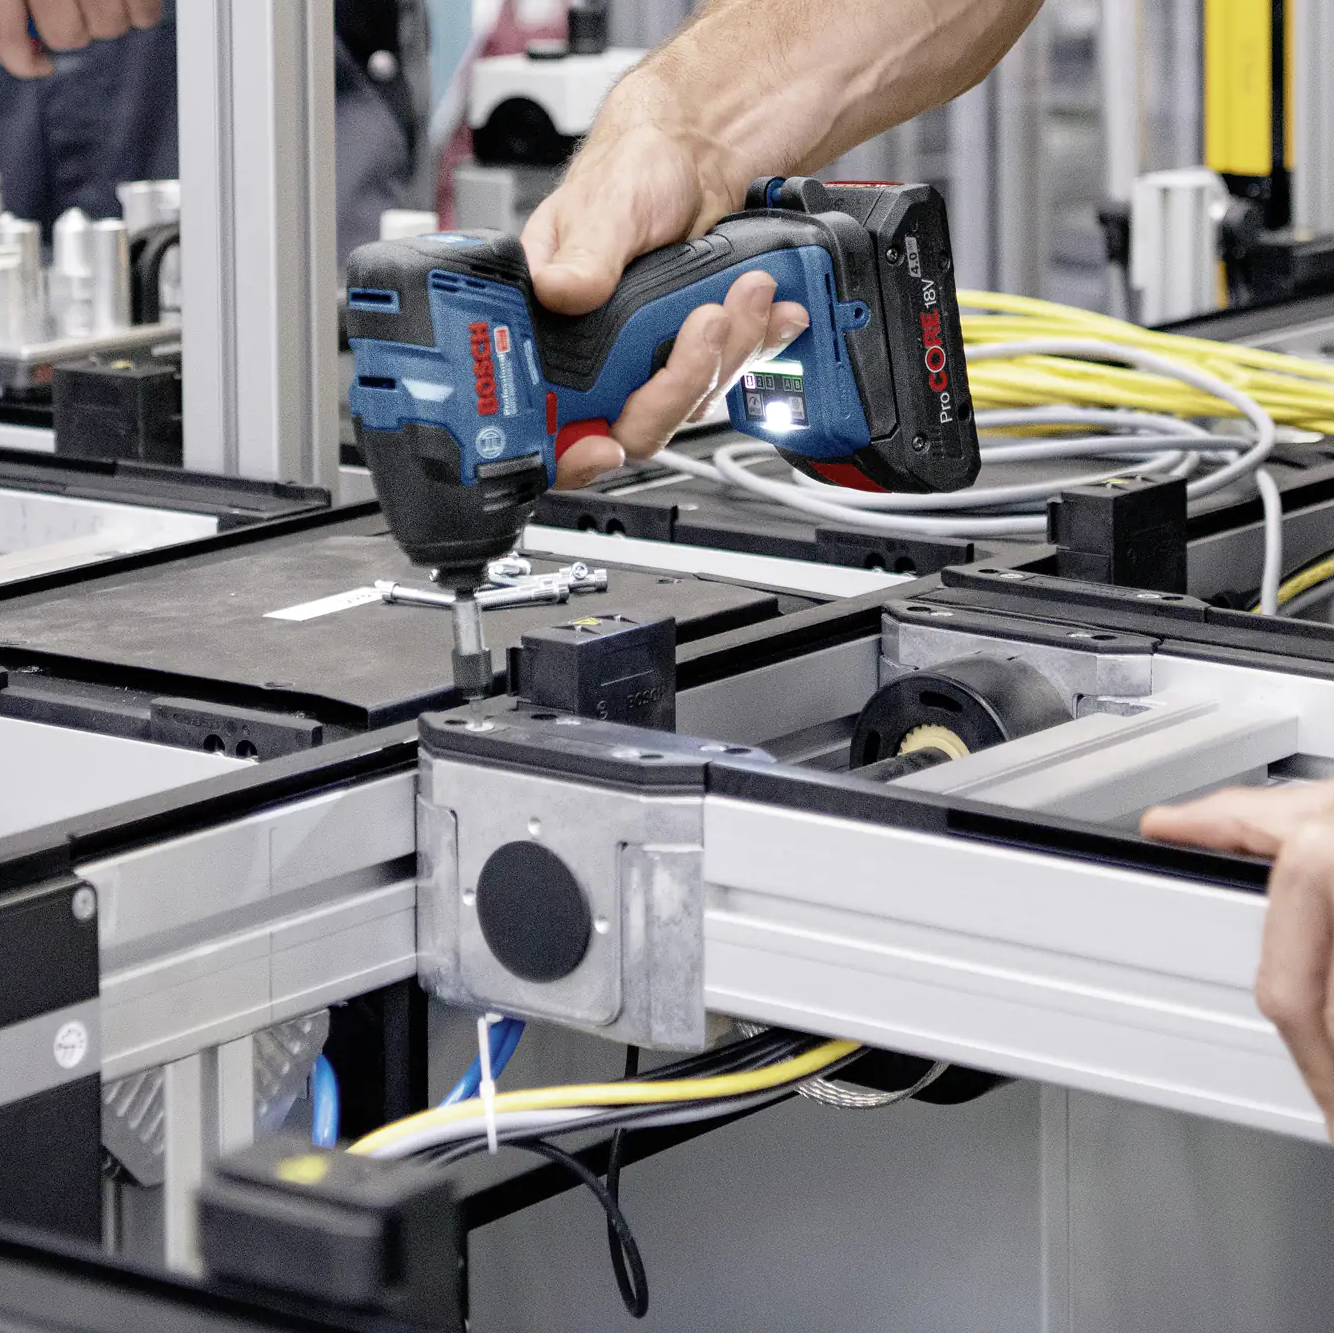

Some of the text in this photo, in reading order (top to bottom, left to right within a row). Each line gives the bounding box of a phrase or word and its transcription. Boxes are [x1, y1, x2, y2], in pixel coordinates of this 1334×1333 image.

[909, 251, 919, 275] 4.0
[921, 278, 937, 309] 18V
[468, 321, 498, 416] BOSCH
